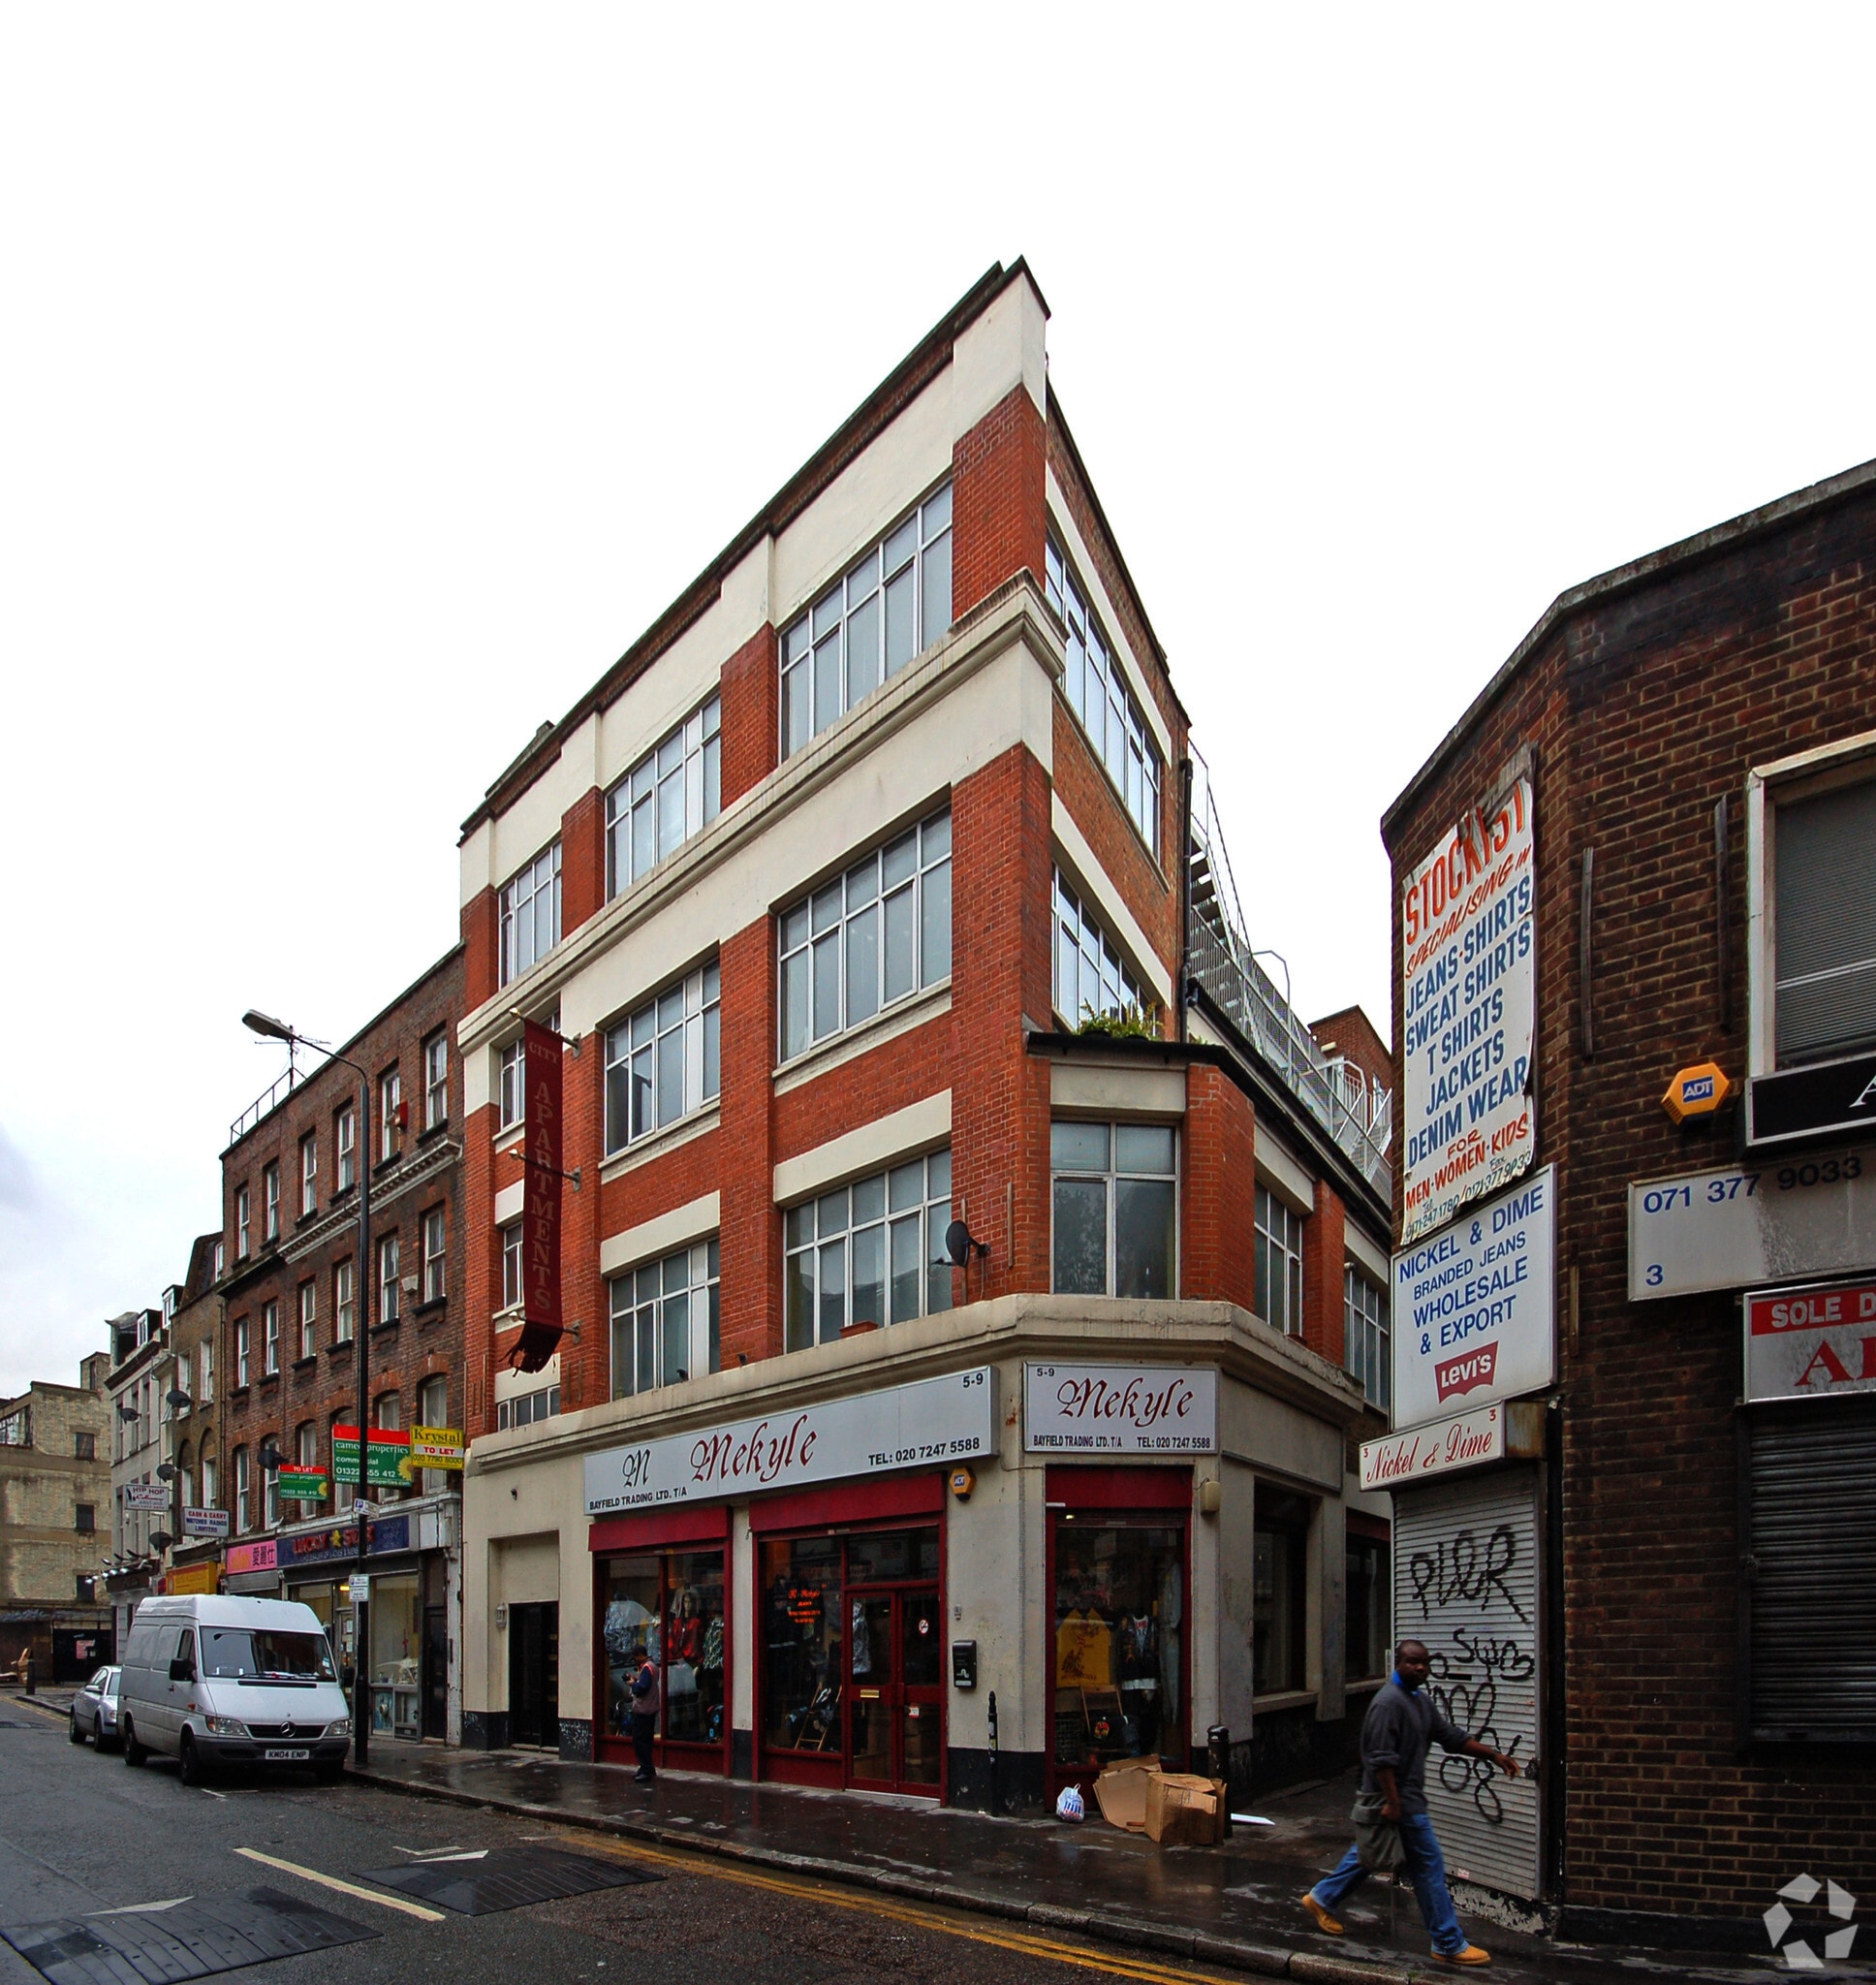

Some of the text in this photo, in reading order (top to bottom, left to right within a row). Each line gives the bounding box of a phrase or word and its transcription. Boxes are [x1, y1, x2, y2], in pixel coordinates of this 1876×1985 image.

[1405, 853, 1514, 979] SPECIALISING
[1405, 875, 1530, 1019] JEANS SHIRTS
[1406, 921, 1530, 1056] SWEAT SHIRTS
[529, 1042, 559, 1063] CITY
[1427, 988, 1503, 1076] T SHIRTS
[1425, 1029, 1504, 1116] JACKETS
[1682, 1079, 1713, 1099] ADT
[1408, 1056, 1527, 1169] DENIM WEAR
[1406, 1112, 1528, 1211] MEN WOMEN KIDS
[1448, 1128, 1483, 1159] FOR
[531, 1081, 554, 1310] APARTMENTS
[1643, 1156, 1862, 1213] 071 377 9033
[1399, 1184, 1544, 1283] NICKEL & DIME
[1413, 1231, 1526, 1301] BRANDED JEANS
[1413, 1255, 1528, 1329] WHOLESALE
[1645, 1264, 1664, 1286] 3
[1421, 1295, 1516, 1355] & EXPORT
[1771, 1296, 1842, 1328] SOLE
[962, 1372, 985, 1389] 5-9
[1037, 1368, 1055, 1377] 5-9
[1056, 1377, 1194, 1428] Mekyle
[1489, 1408, 1496, 1422] 3
[335, 1441, 360, 1450] came
[367, 1444, 409, 1454] properties
[414, 1428, 460, 1443] Krystal
[689, 1413, 817, 1483] Mekyle
[868, 1436, 981, 1467] TEL: 020 7247 5588
[1033, 1434, 1210, 1449] BAYFIELD TRADING LTD. T/A TEL: 020 7247 5588
[1366, 1423, 1492, 1482] Nickel & Dime
[589, 1497, 621, 1511] BAYFIELD
[621, 1492, 653, 1505] TRADING
[673, 1486, 687, 1497] T/A
